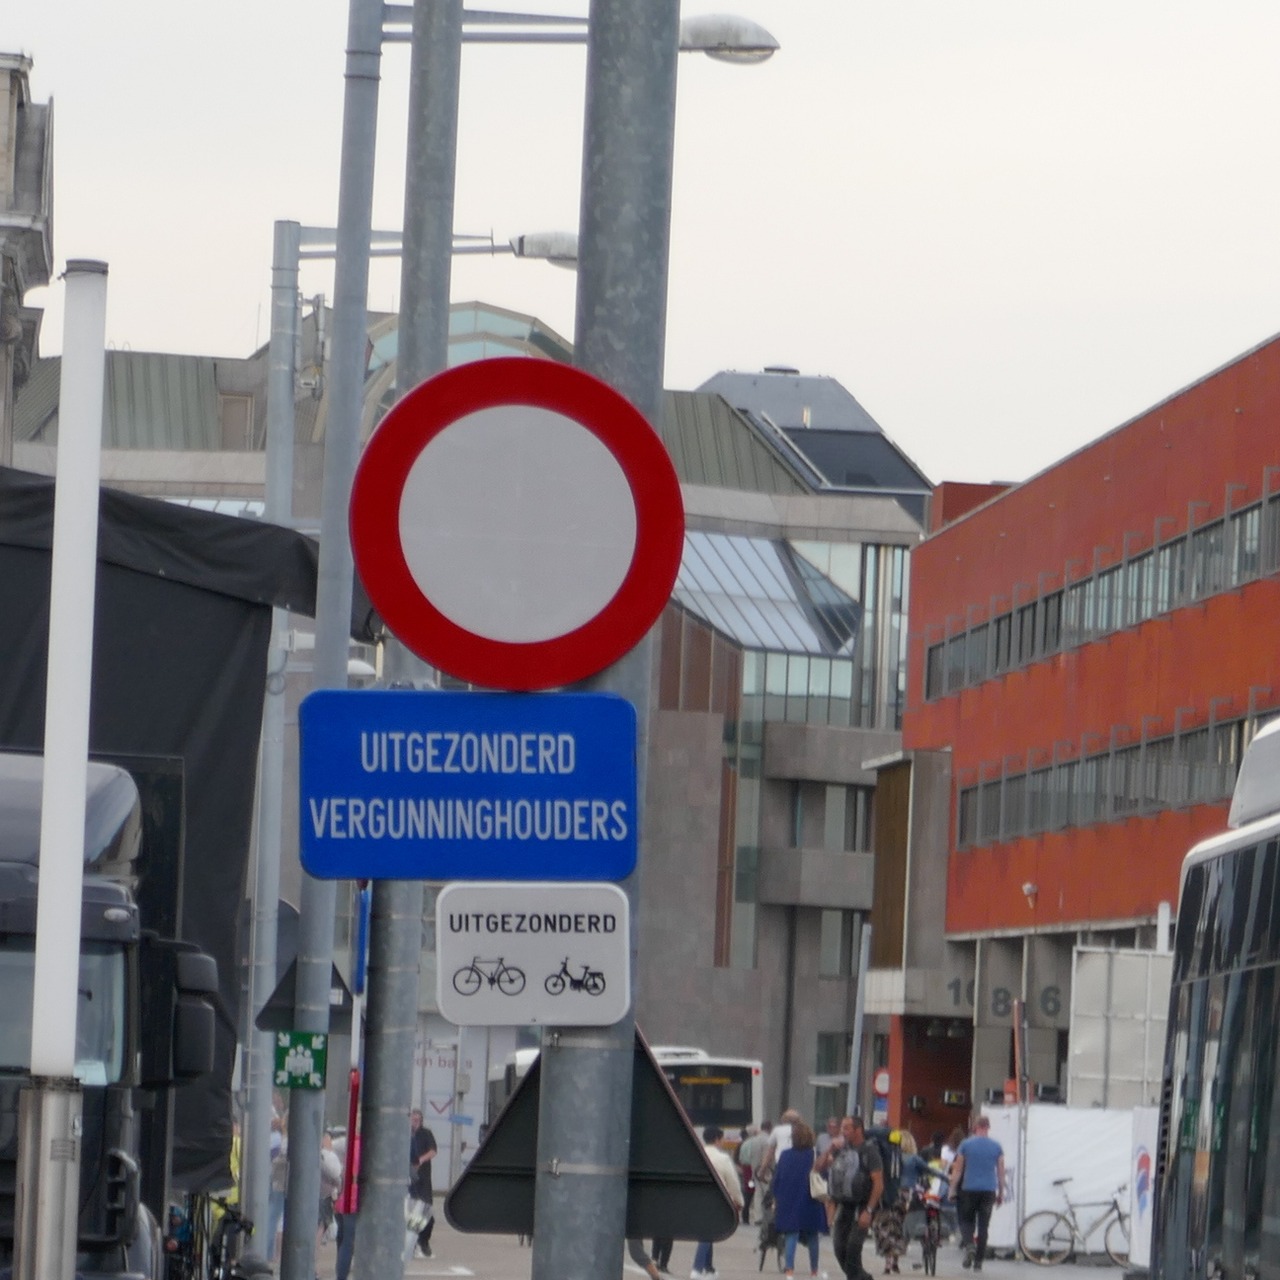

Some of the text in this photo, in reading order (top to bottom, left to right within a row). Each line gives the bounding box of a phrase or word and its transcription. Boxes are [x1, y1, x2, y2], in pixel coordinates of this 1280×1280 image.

[361, 732, 575, 774] UITGEZONDERD
[310, 798, 627, 841] VERGUNNINGHOUDERS
[449, 913, 617, 934] UITGEZONDERD
